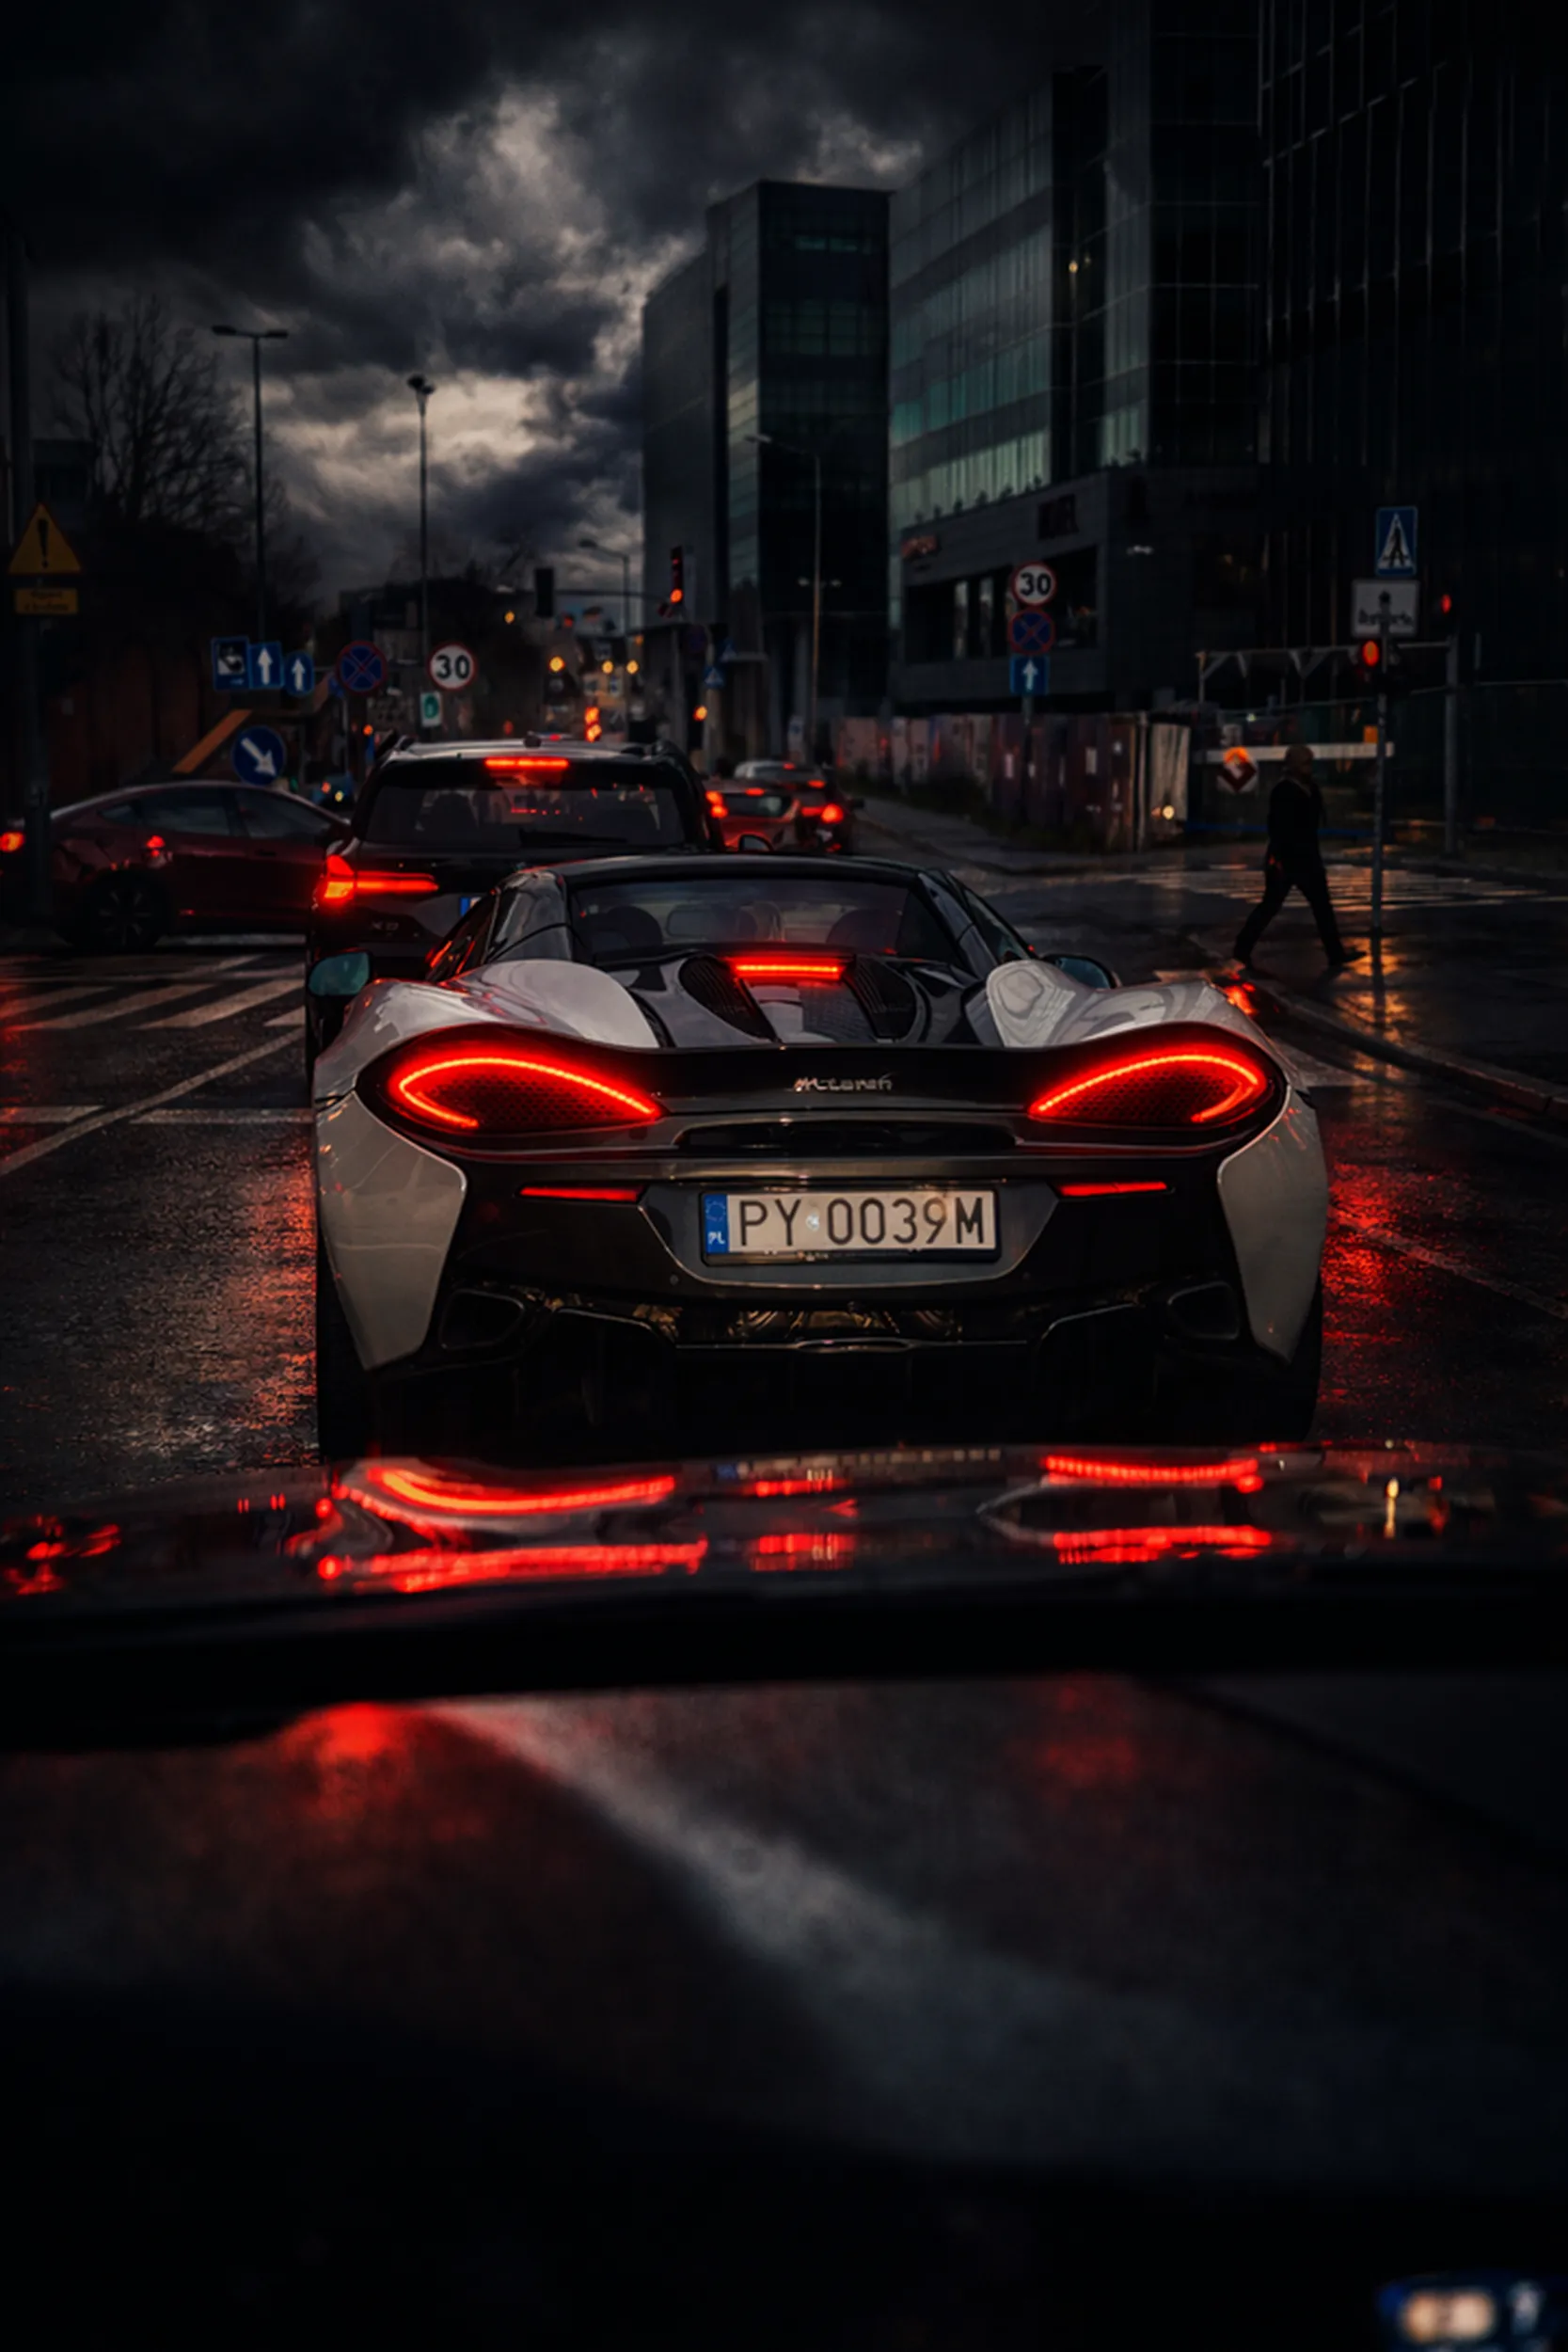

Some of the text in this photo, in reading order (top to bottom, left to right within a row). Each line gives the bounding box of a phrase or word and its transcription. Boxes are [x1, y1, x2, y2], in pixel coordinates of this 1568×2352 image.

[1021, 573, 1051, 596] 30
[436, 655, 469, 678] 30
[739, 1197, 984, 1247] PY 0039M
[707, 1232, 725, 1246] PL
